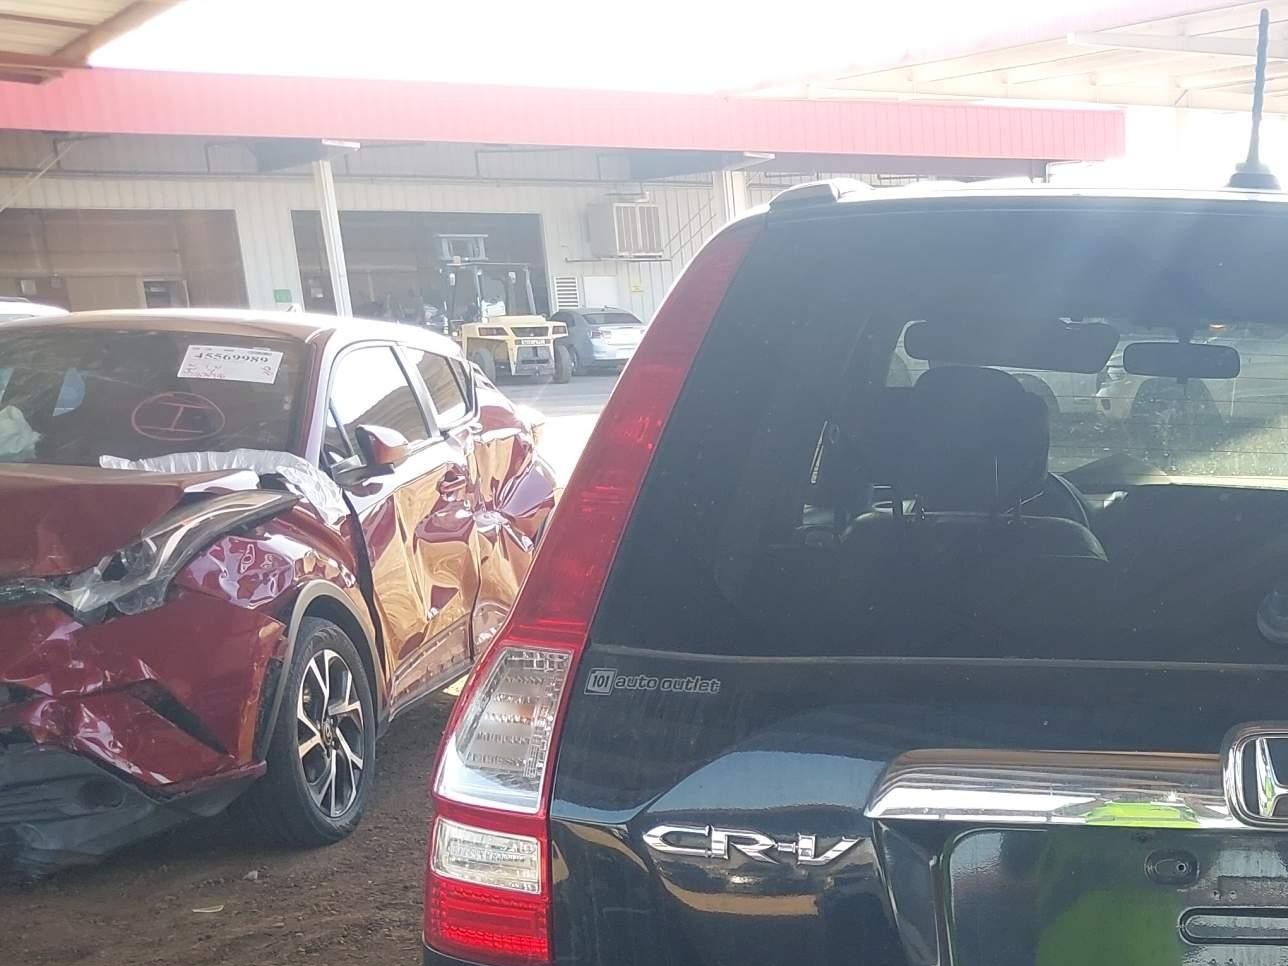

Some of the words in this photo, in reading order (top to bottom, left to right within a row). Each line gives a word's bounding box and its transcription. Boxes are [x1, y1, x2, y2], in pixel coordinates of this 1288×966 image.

[615, 674, 659, 690] auto
[660, 676, 721, 694] outlet
[642, 824, 865, 866] CR-V
